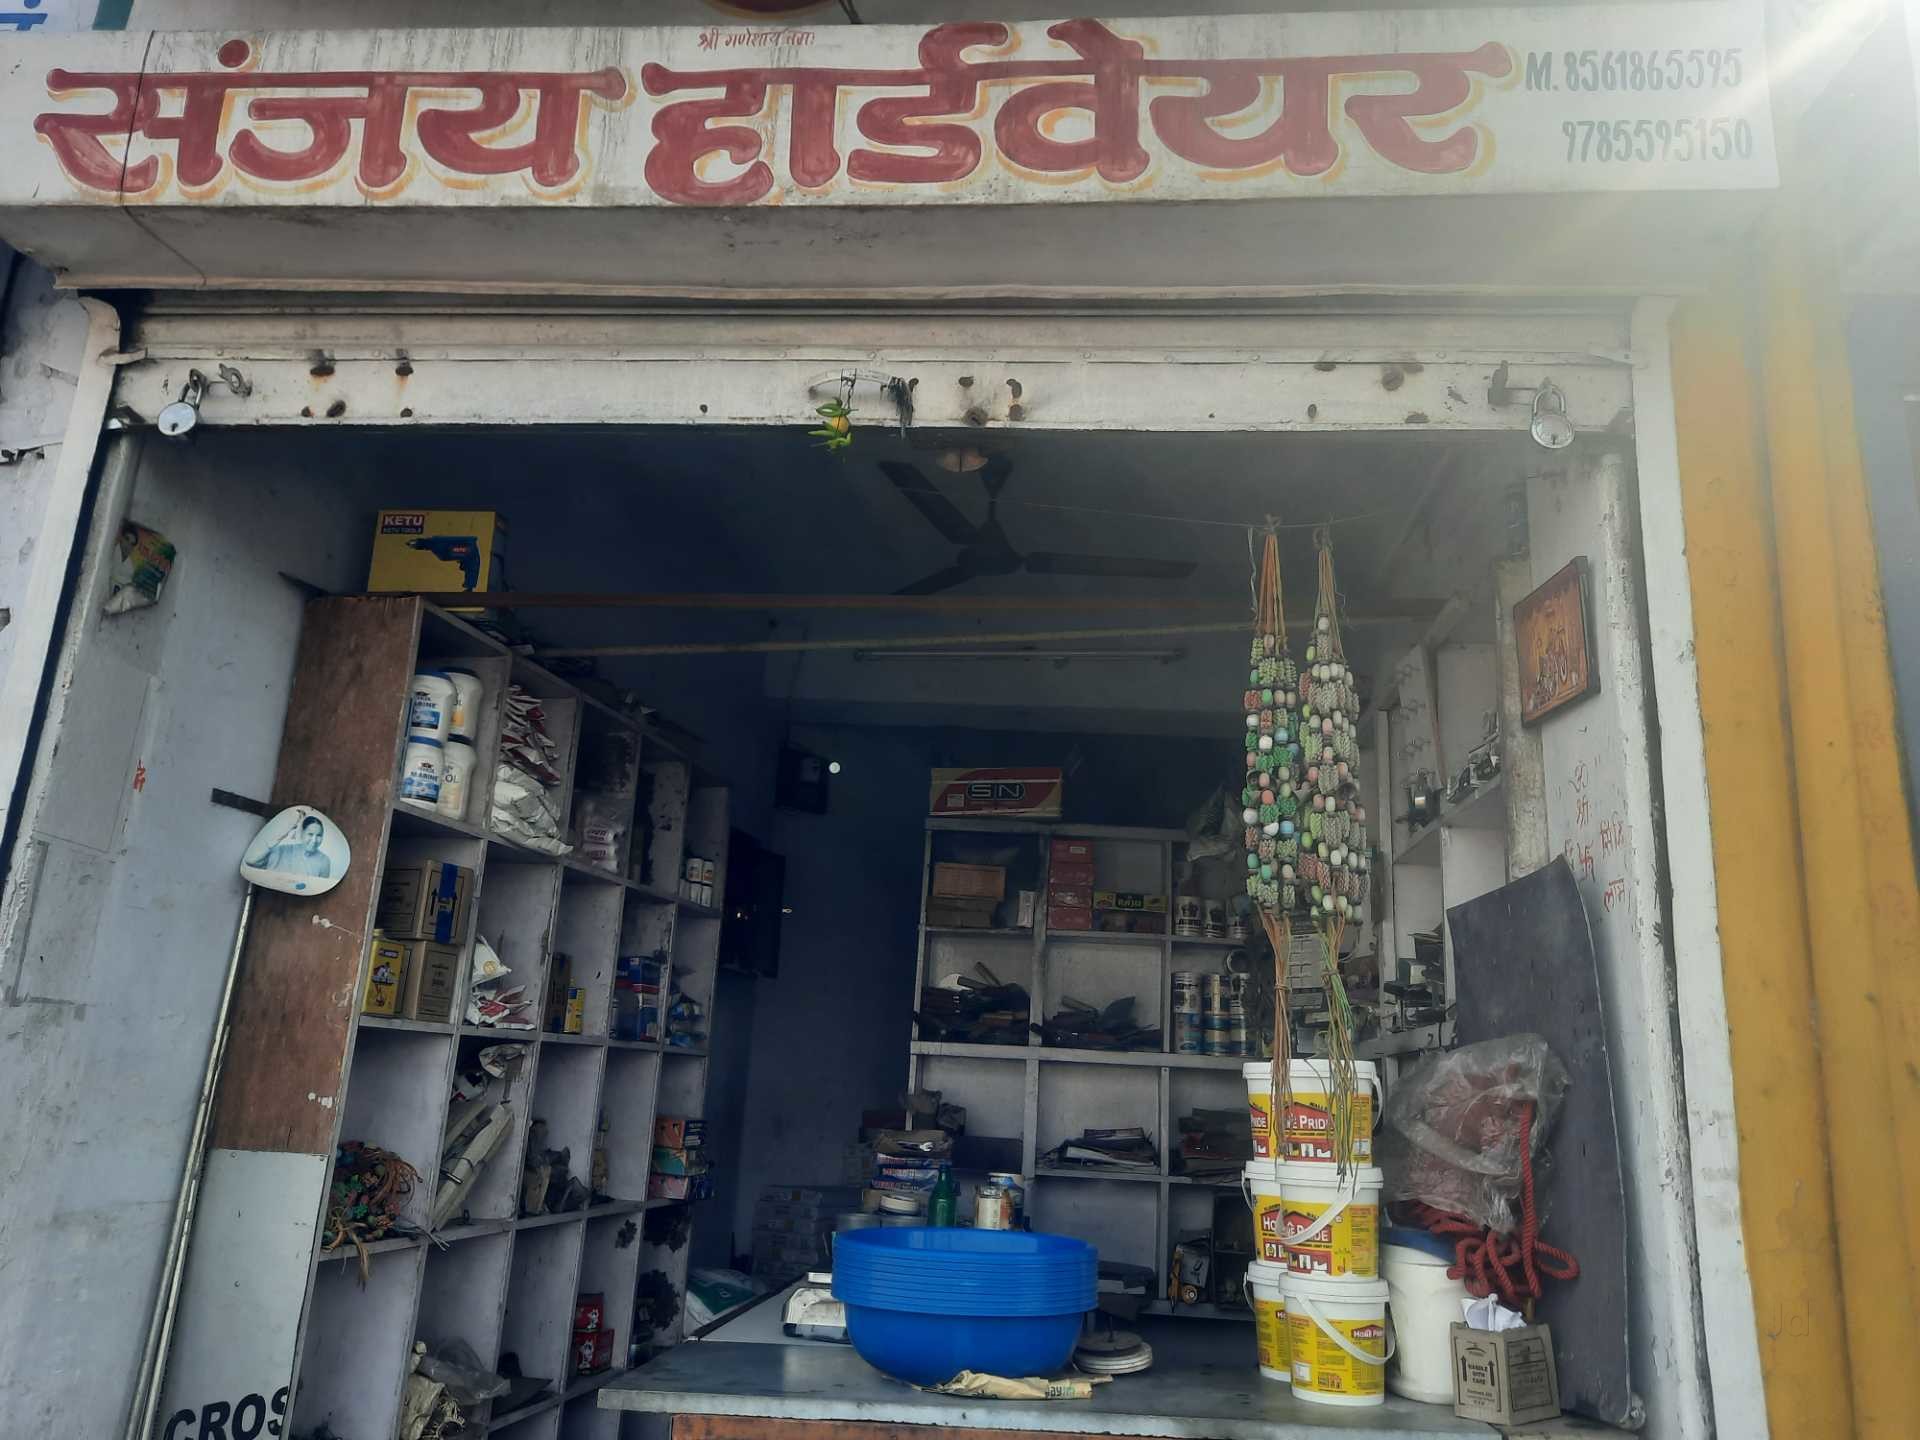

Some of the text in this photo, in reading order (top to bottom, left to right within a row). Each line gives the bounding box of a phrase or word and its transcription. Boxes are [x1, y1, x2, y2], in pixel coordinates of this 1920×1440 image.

[698, 28, 719, 50] श्री
[1564, 48, 1743, 92] 8561865595
[34, 18, 1513, 205] संजय हार्डवेयर
[1562, 118, 1753, 163] 9785595150
[384, 515, 423, 526] KETU
[1299, 1115, 1330, 1130] PRID
